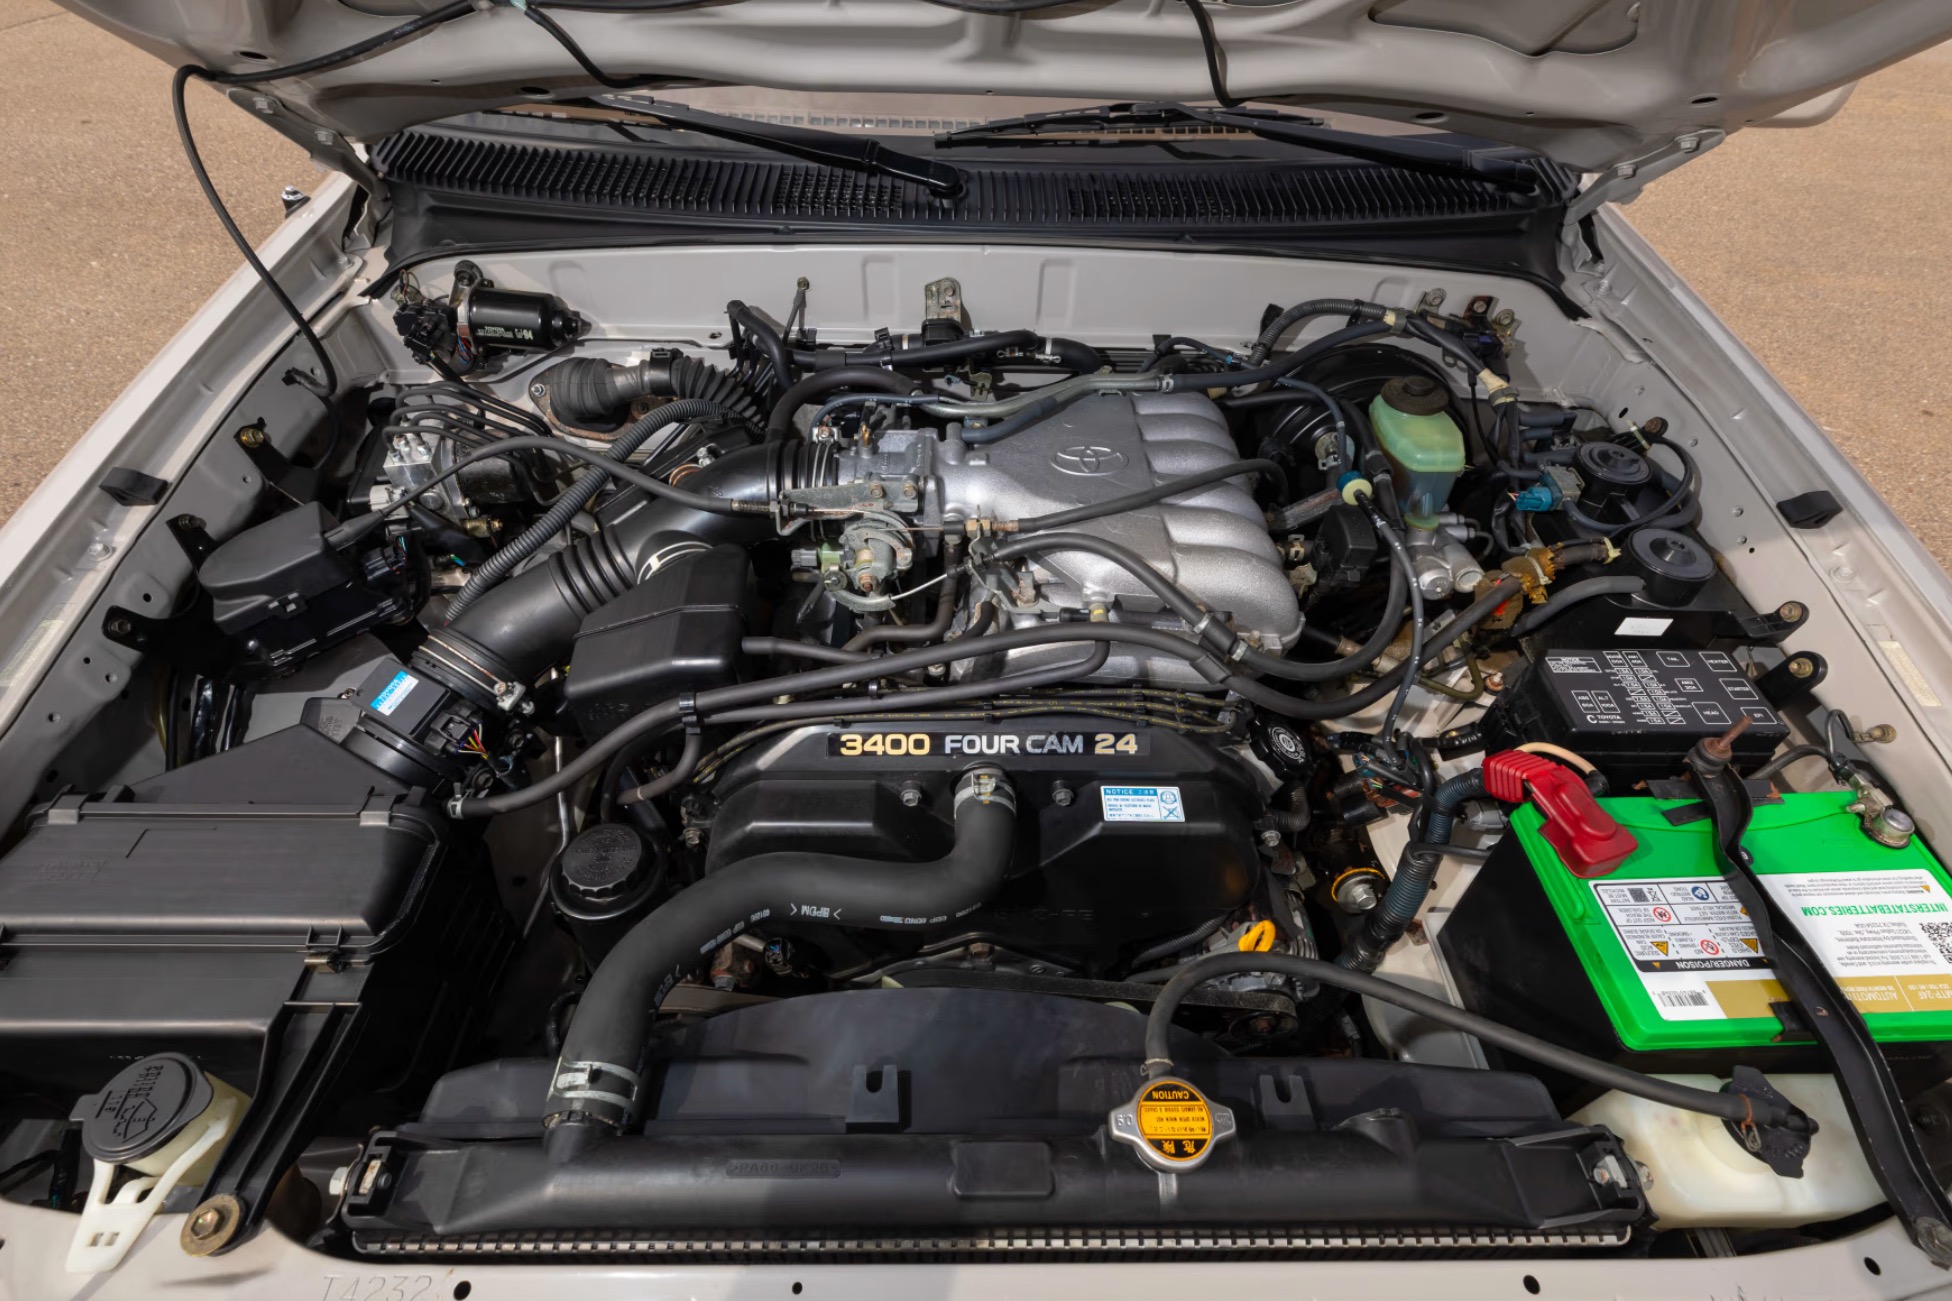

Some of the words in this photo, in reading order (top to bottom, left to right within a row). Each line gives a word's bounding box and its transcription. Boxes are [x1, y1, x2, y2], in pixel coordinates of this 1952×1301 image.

[840, 733, 930, 755] 3400
[945, 733, 1020, 755] FOUR
[1026, 734, 1084, 755] CAM
[1094, 733, 1138, 755] 24
[1801, 902, 1948, 916] INTERSTATEBATTERIES.COM
[1675, 959, 1750, 969] DANGER/POISON
[1152, 1091, 1189, 1099] CAUTION
[1116, 1114, 1132, 1126] 0.9
